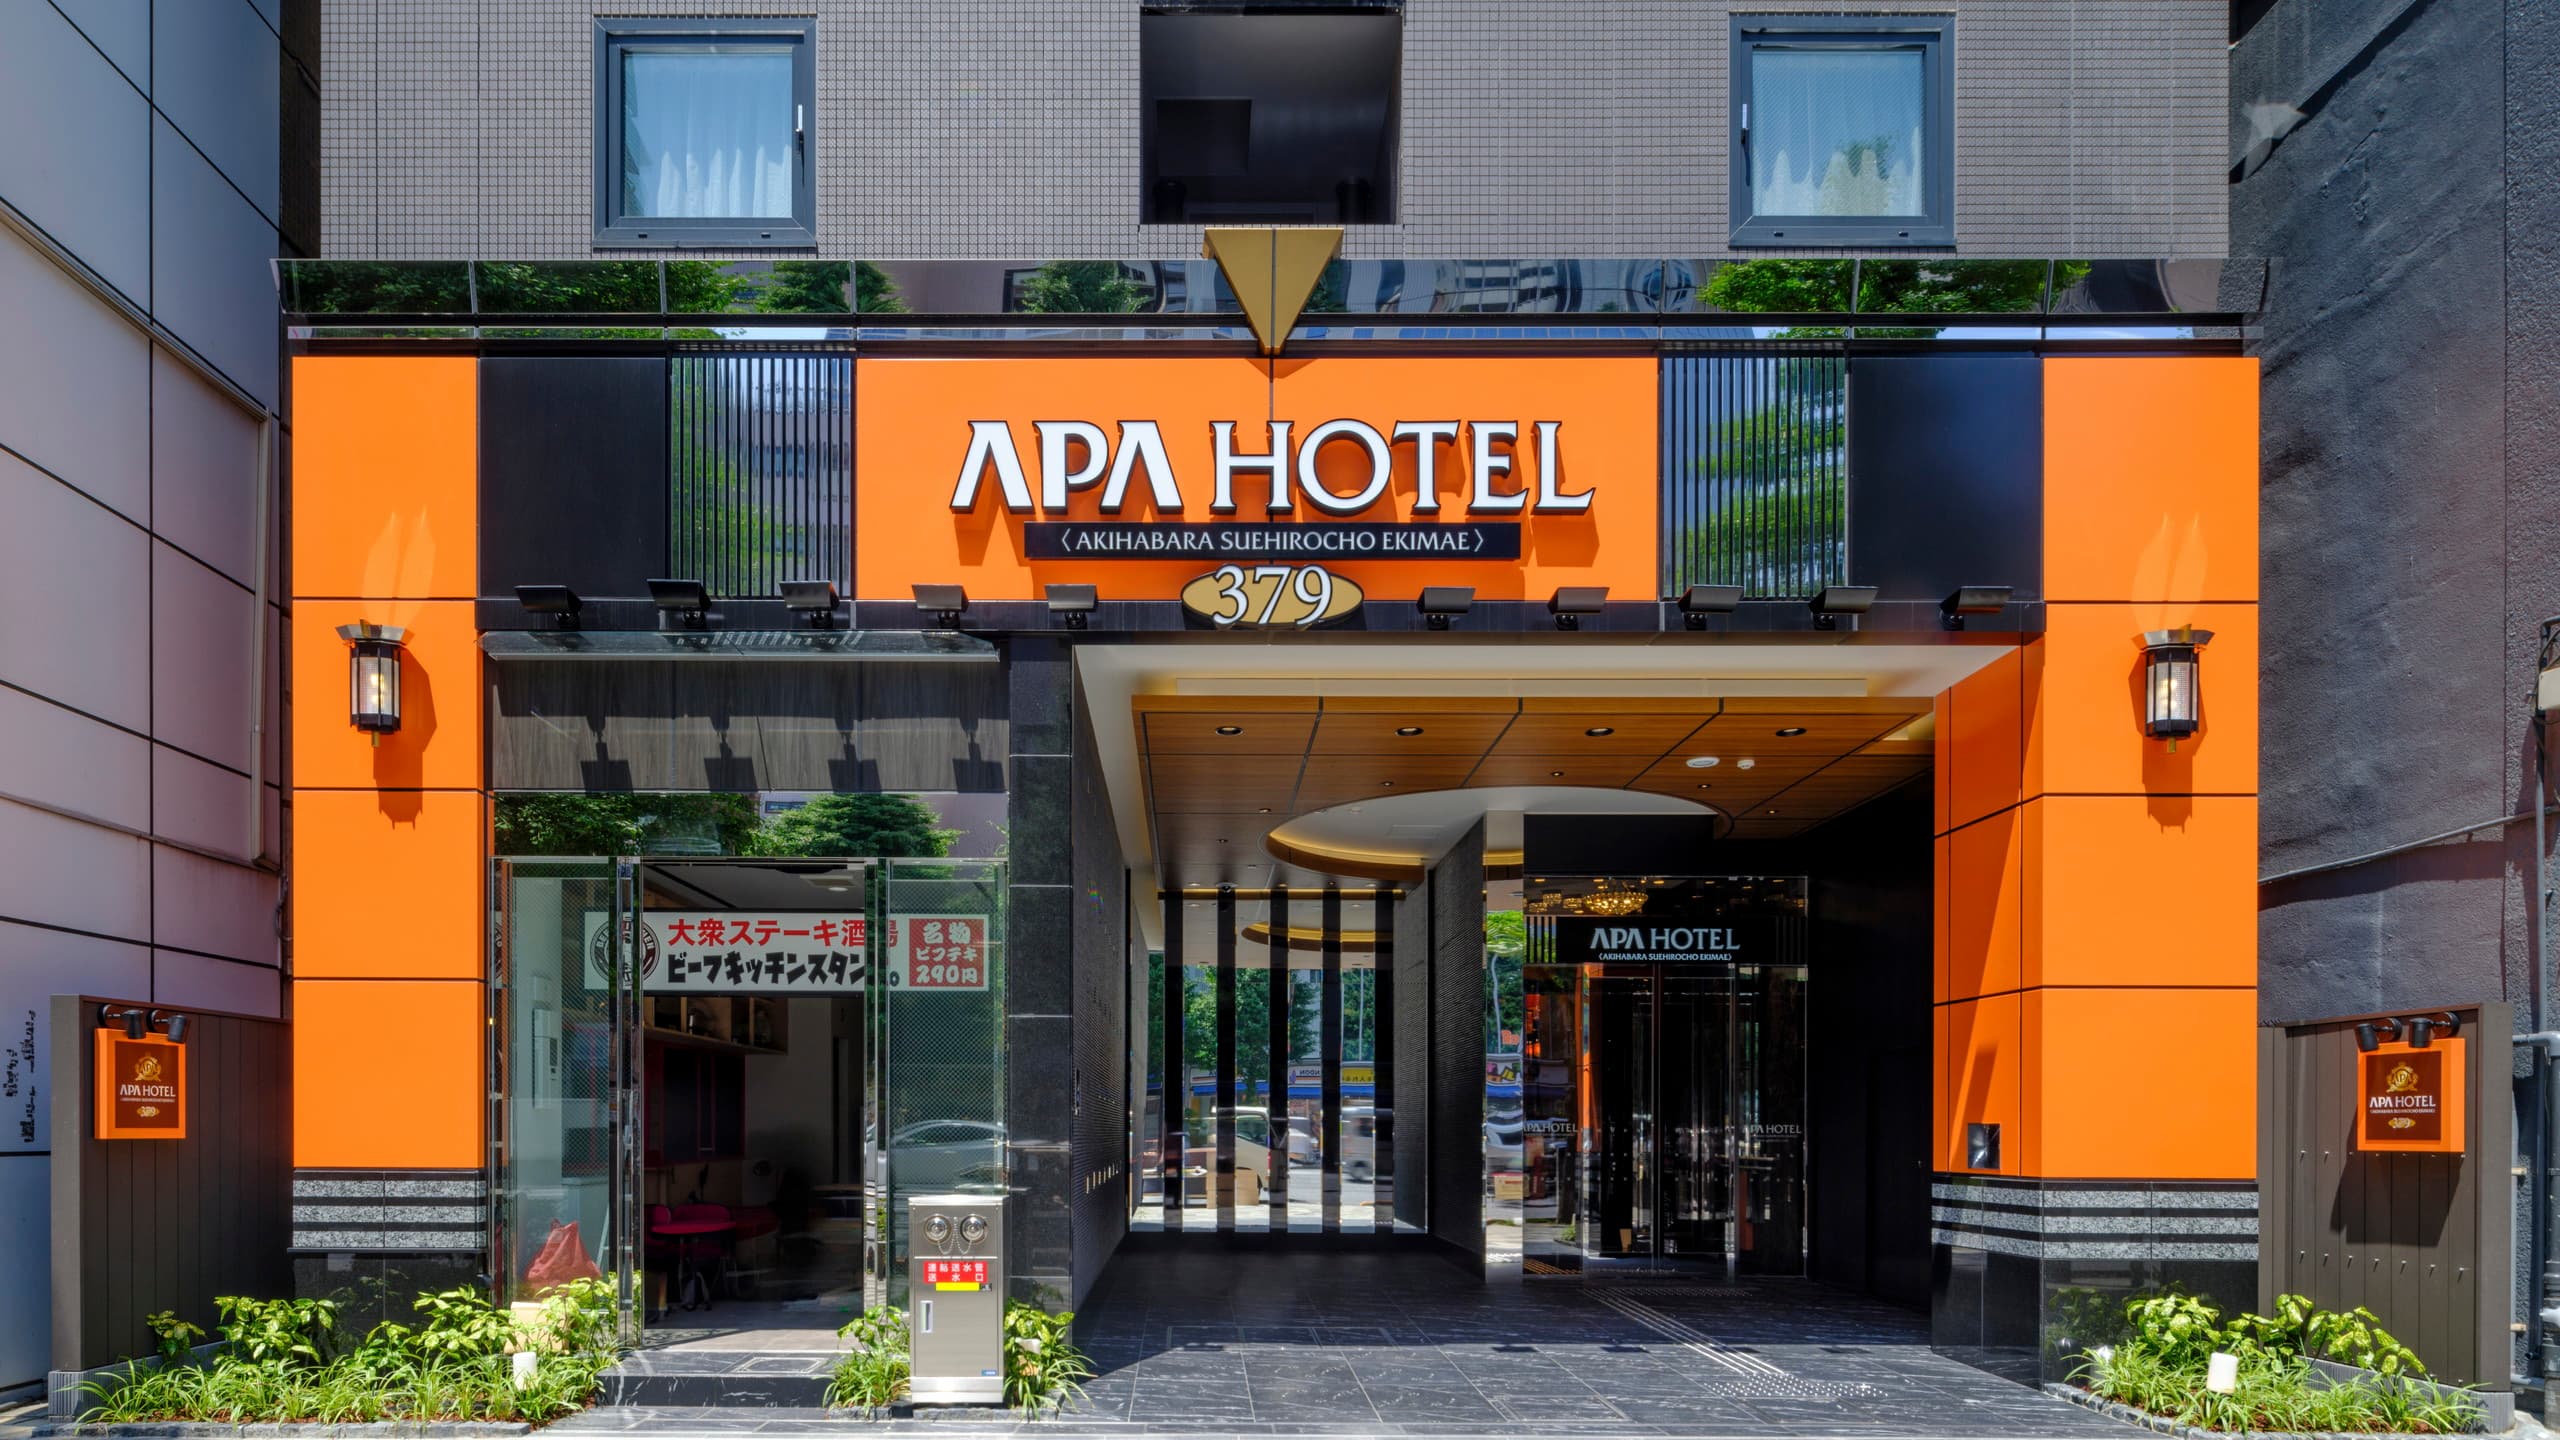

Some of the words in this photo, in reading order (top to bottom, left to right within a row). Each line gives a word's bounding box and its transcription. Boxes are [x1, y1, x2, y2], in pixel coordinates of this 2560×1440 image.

[950, 420, 1184, 513] APA
[1208, 418, 1597, 514] HOTEL
[1220, 531, 1376, 550] SUEHIROCHO
[1211, 564, 1333, 626] 379
[923, 921, 970, 945] 名物
[1590, 927, 1645, 949] APA
[1650, 927, 1741, 950] HOTEL
[916, 946, 977, 962] ビフテキ
[1648, 953, 1699, 961] SUEHIROCHO
[916, 965, 978, 984] 290円
[120, 1084, 141, 1096] APA
[142, 1085, 176, 1097] HOTEL
[2369, 1096, 2393, 1108] APA
[2395, 1095, 2436, 1108] HOTEL
[1542, 1122, 1578, 1133] HOTEL
[1765, 1124, 1802, 1134] HOTEL
